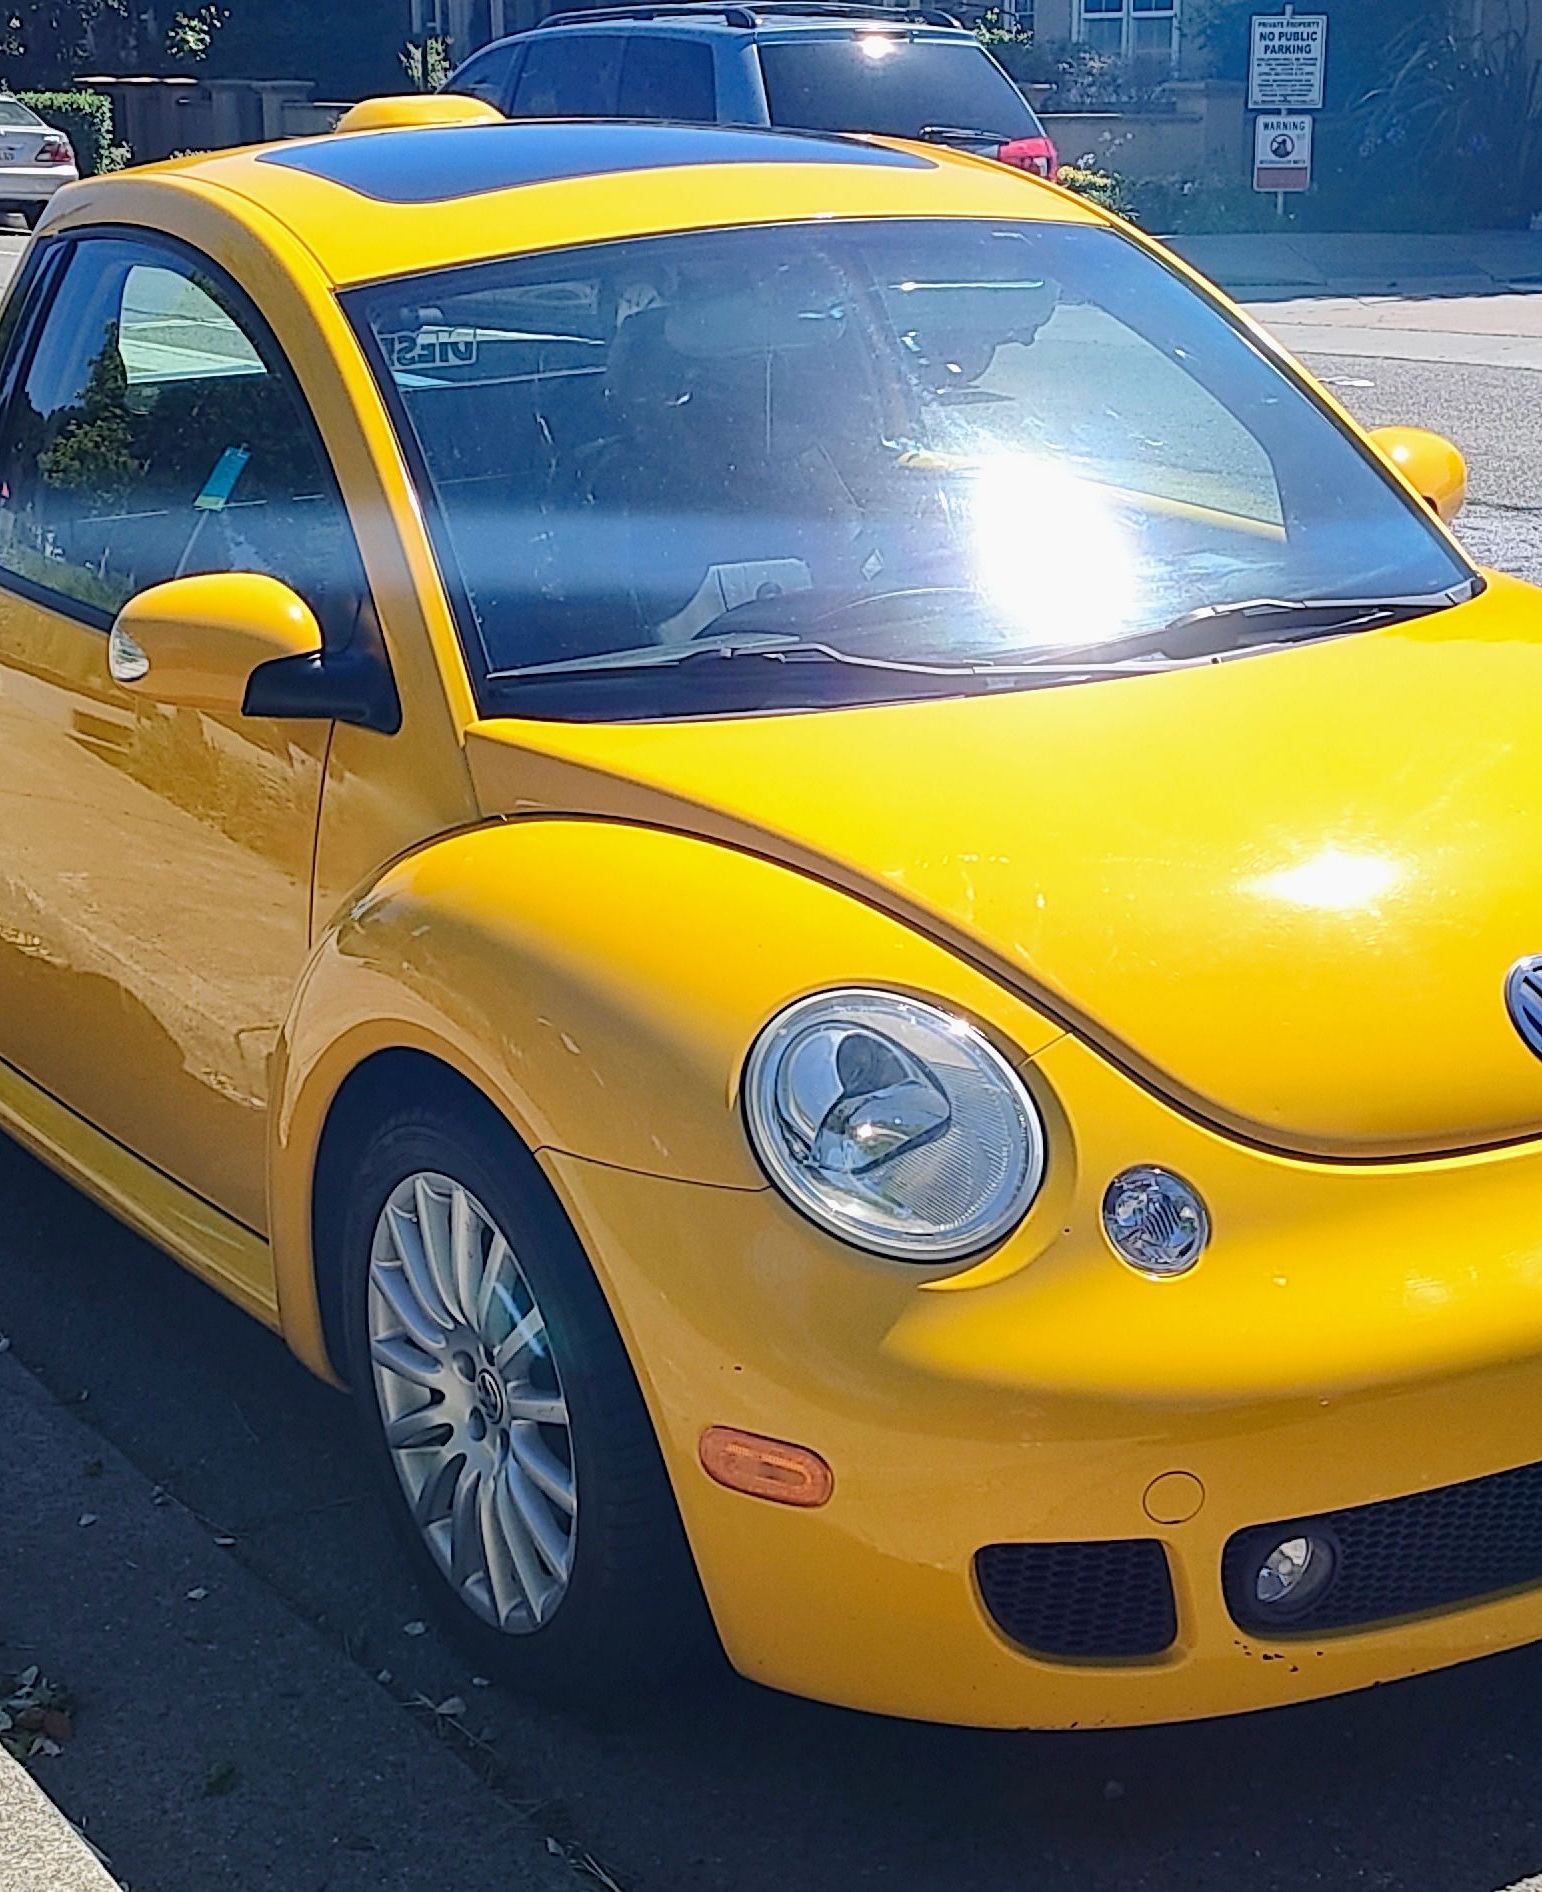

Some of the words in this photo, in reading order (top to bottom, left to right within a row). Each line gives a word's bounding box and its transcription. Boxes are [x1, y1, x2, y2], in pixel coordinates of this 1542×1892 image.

[1259, 31, 1276, 42] NO
[1278, 31, 1318, 42] PUBLIC
[1263, 43, 1312, 55] PARKING
[1262, 121, 1306, 132] WARNING
